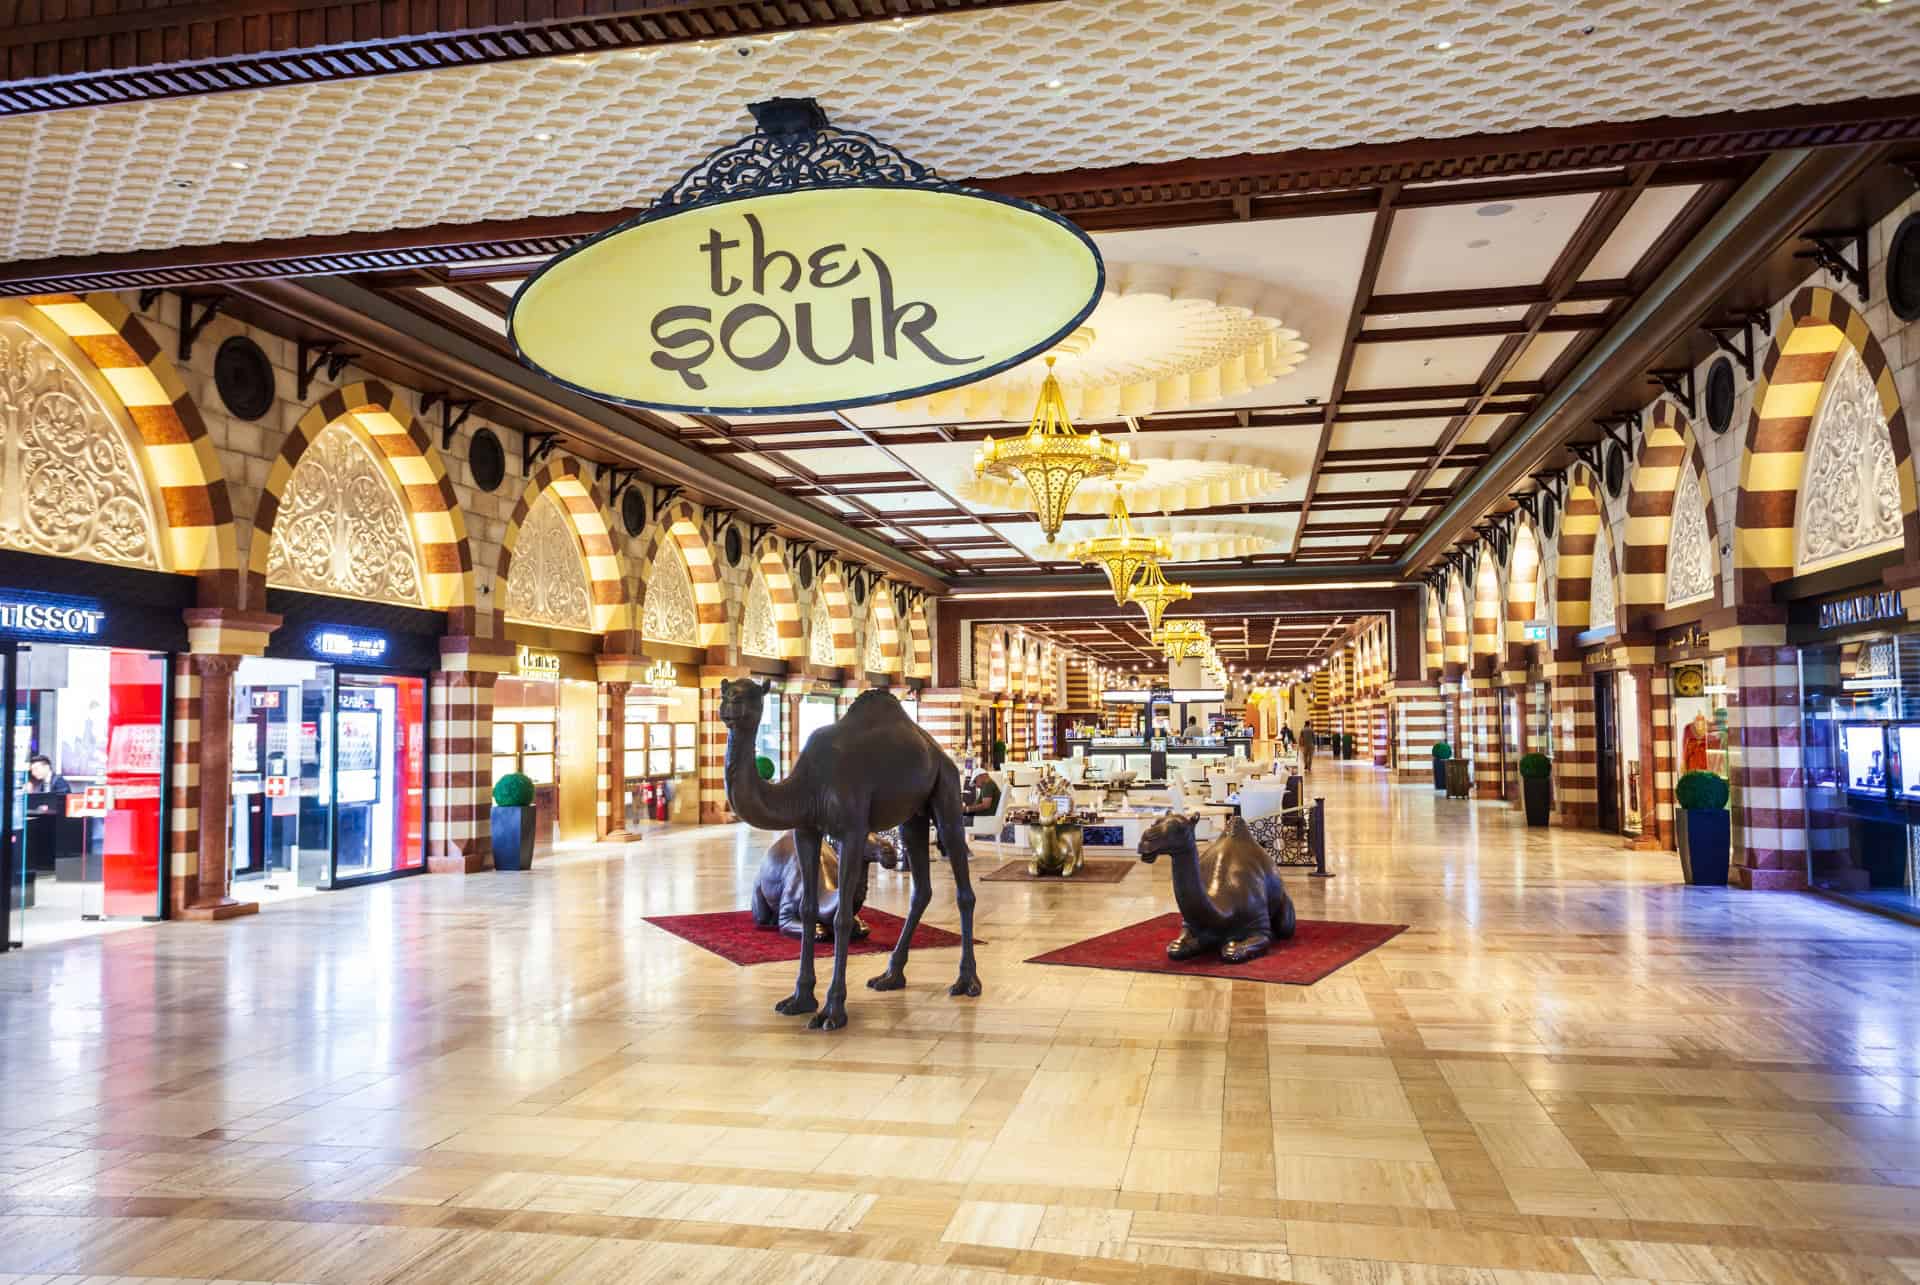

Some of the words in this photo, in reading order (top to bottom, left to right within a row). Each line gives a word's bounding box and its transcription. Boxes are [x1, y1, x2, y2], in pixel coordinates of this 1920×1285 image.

[700, 213, 860, 297] the
[650, 247, 985, 390] souk
[0, 602, 105, 634] TISSOT
